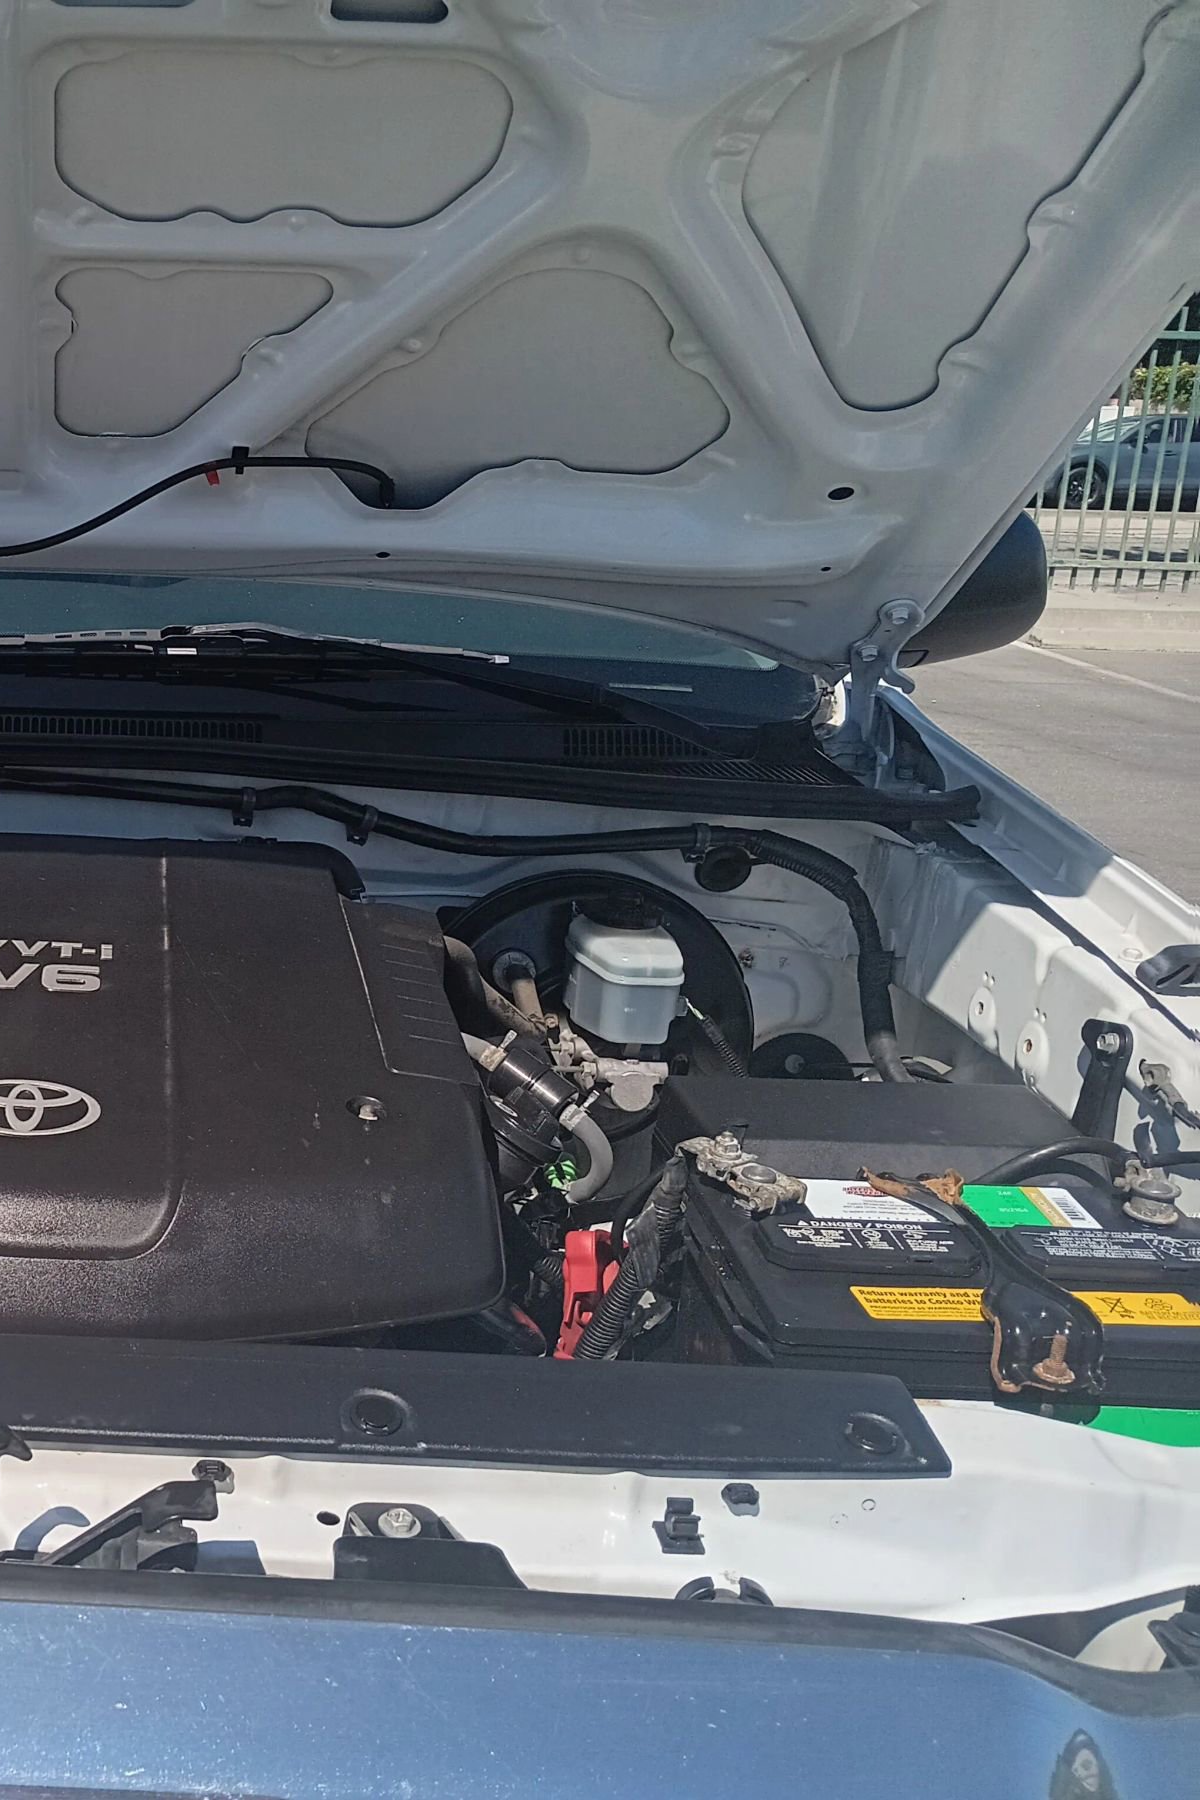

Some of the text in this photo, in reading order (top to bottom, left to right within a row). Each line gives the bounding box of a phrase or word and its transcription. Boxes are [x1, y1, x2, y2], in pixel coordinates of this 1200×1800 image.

[810, 1220, 862, 1228] DANGER
[874, 1222, 923, 1230] POISON
[858, 1289, 896, 1297] Return
[897, 1291, 947, 1299] warranty
[864, 1296, 914, 1304] batteries
[928, 1297, 964, 1305] Costco
